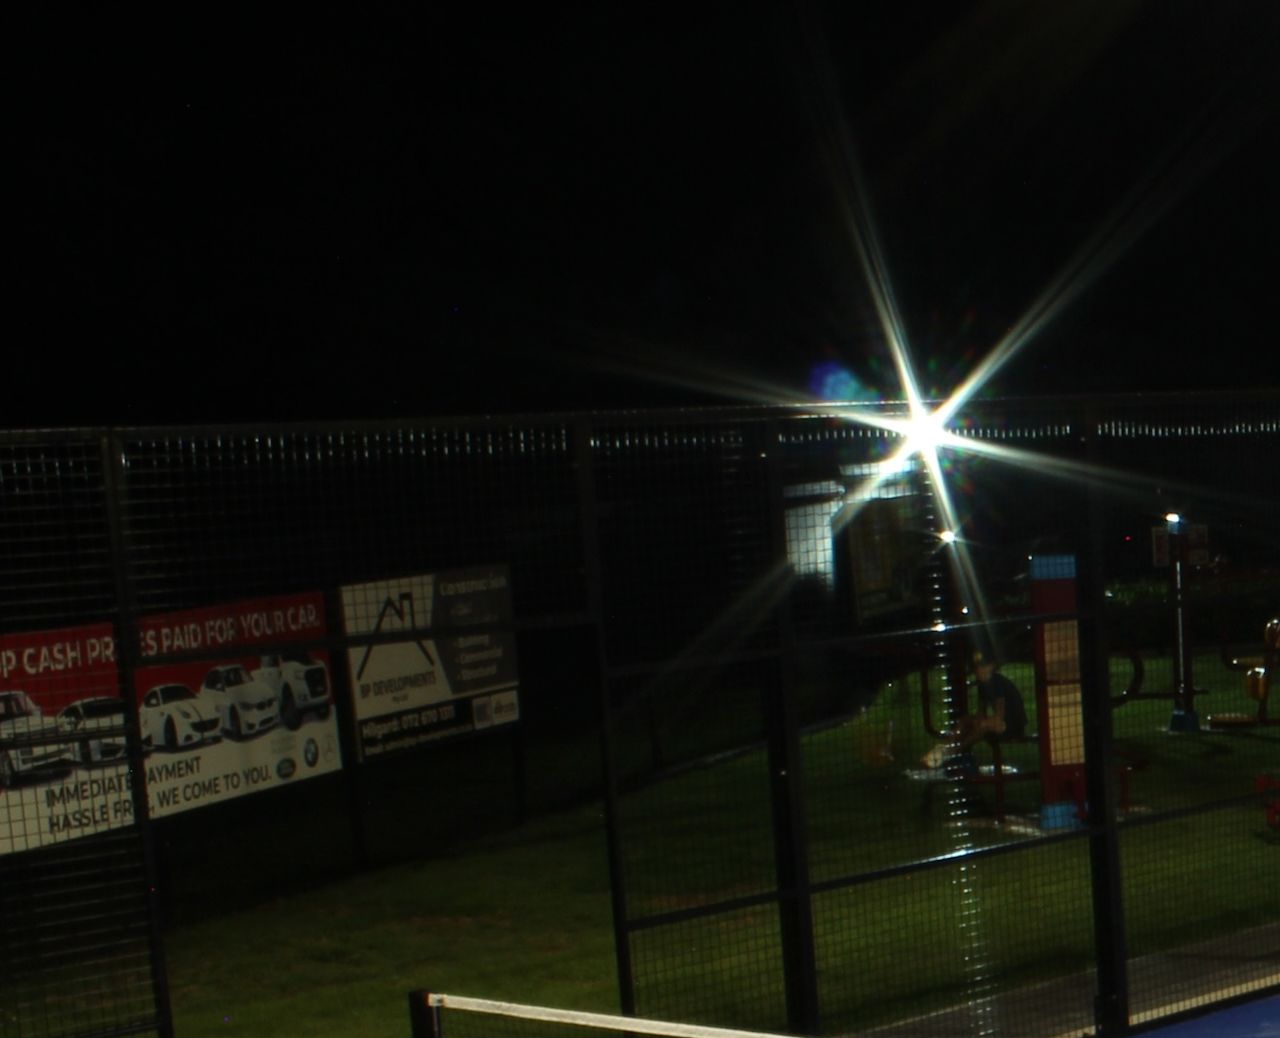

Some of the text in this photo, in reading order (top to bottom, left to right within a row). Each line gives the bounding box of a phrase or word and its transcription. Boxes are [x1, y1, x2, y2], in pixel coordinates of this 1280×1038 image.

[23, 640, 82, 675] CASH
[161, 623, 201, 653] PAID
[205, 617, 235, 645] FOR
[241, 611, 284, 639] YOUR
[46, 756, 202, 808] IMMEDIATE AYMENT
[49, 803, 110, 834] HASSLE
[157, 786, 180, 808] WE
[183, 776, 221, 802] COME
[223, 772, 241, 792] TO
[243, 765, 271, 787] YOU.
